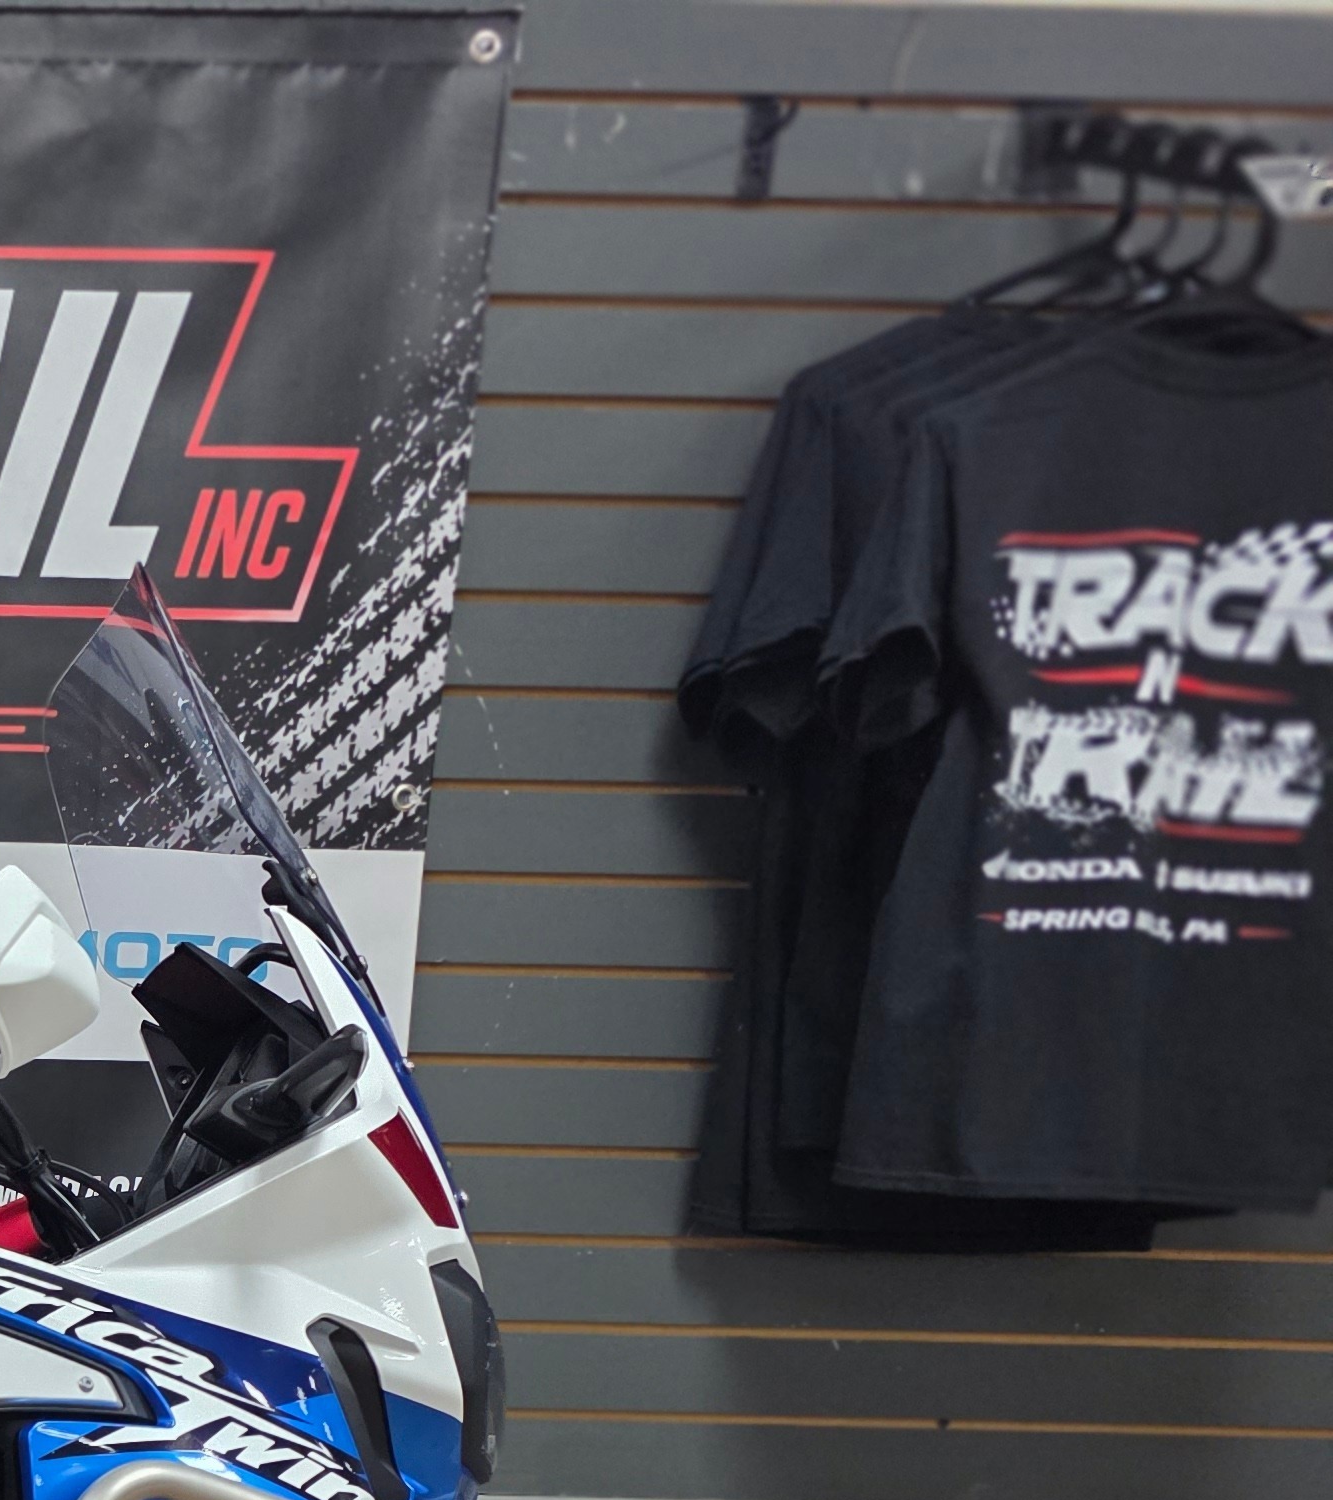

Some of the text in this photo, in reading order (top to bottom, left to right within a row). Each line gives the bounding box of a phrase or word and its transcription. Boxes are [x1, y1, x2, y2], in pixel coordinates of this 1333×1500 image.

[174, 487, 306, 580] INC
[995, 546, 1333, 663] TRACK
[1136, 649, 1182, 703] N
[1004, 906, 1130, 932] SPRING
